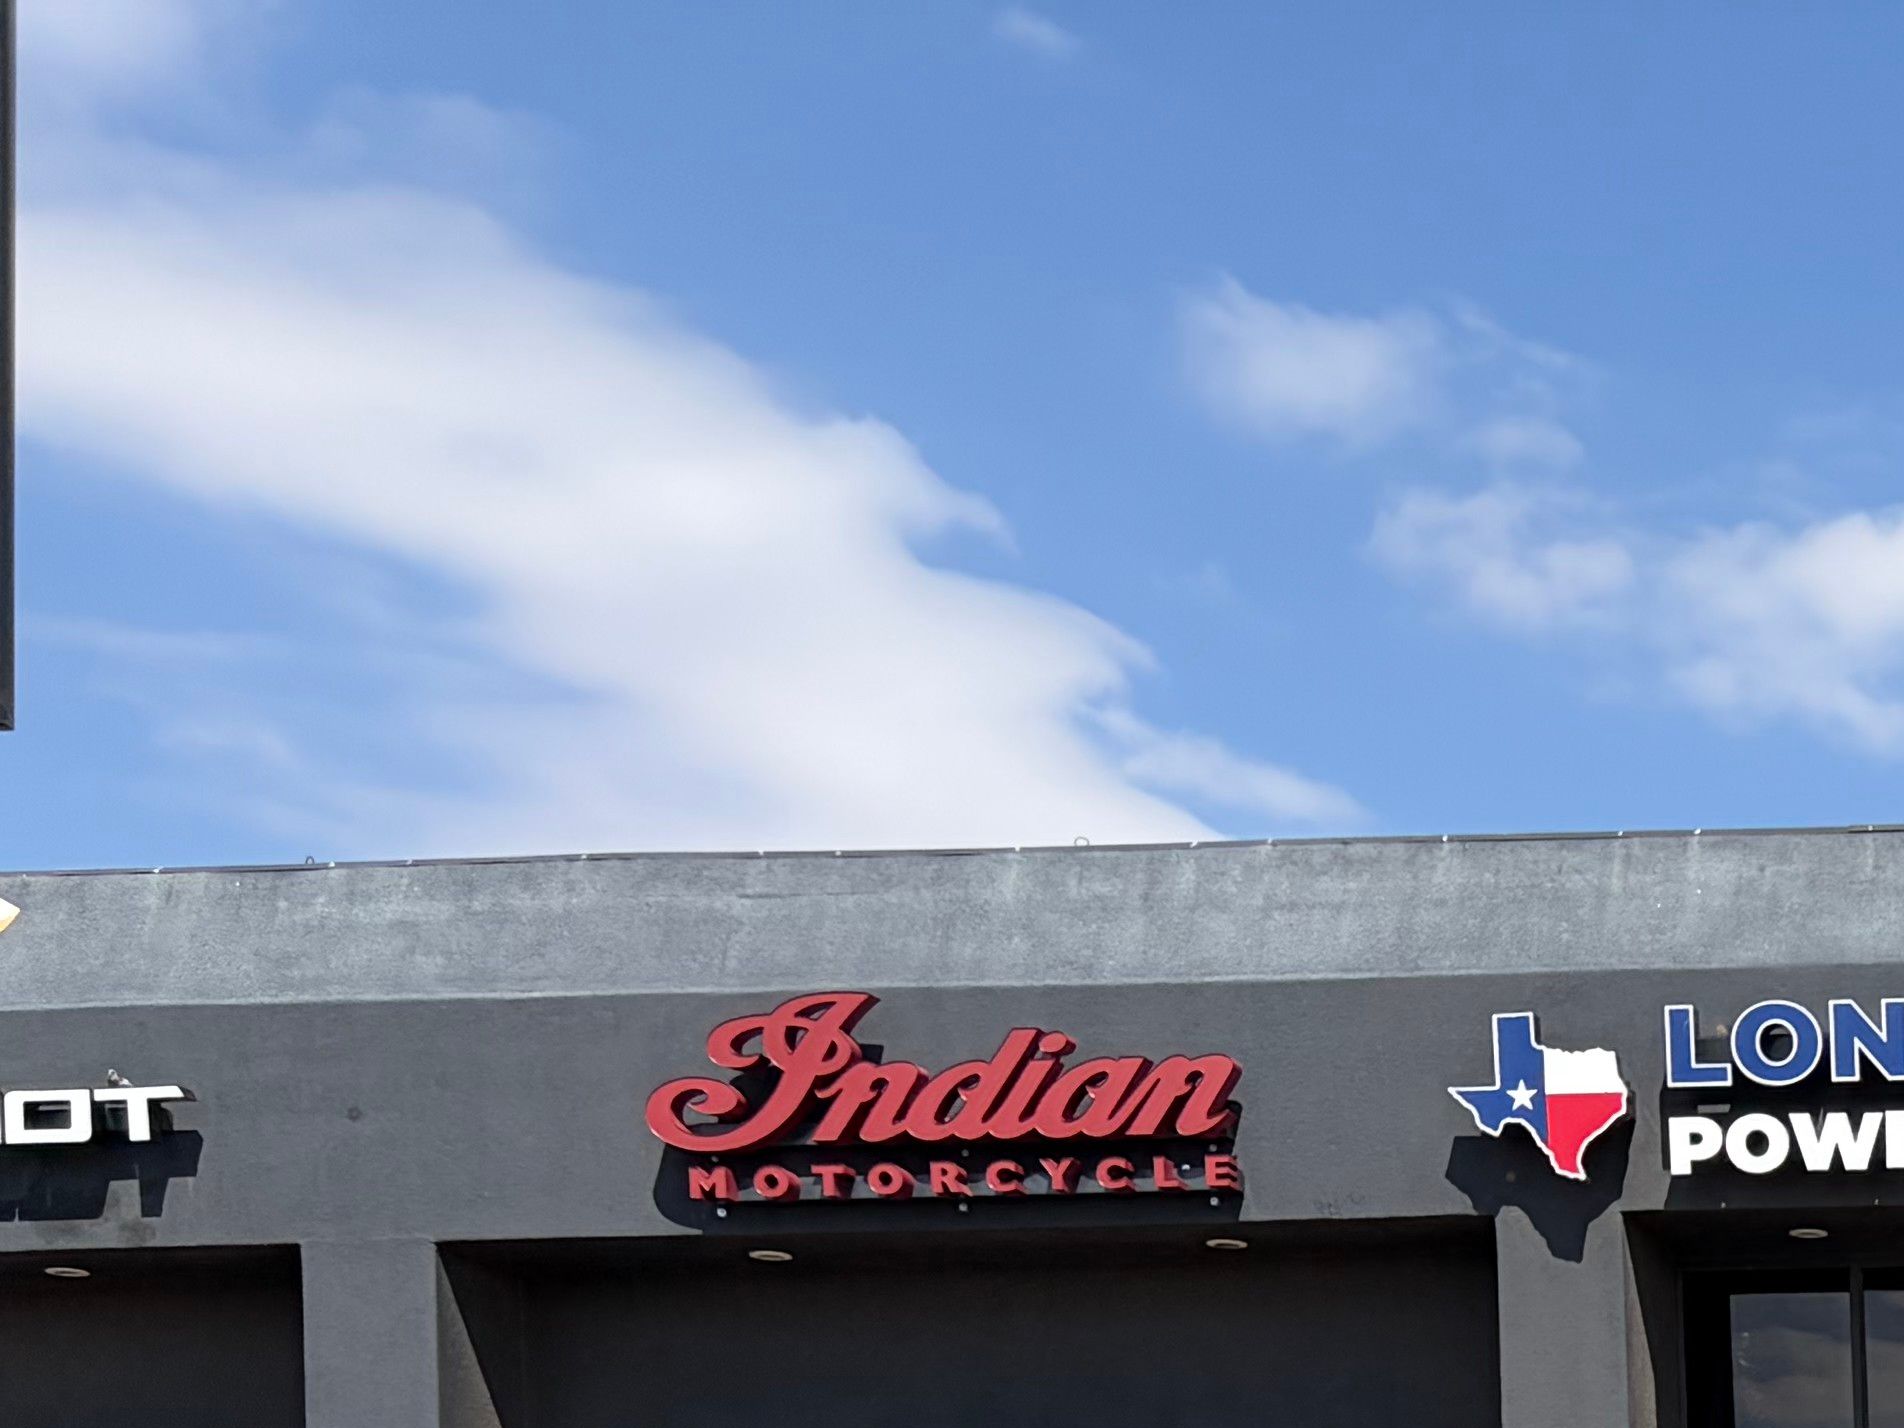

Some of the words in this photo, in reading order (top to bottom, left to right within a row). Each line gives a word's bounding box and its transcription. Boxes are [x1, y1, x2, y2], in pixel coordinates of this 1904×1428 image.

[645, 990, 1242, 1153] Indian
[0, 1085, 185, 1145] OT
[688, 1153, 1241, 1202] MOTORCYCLE
